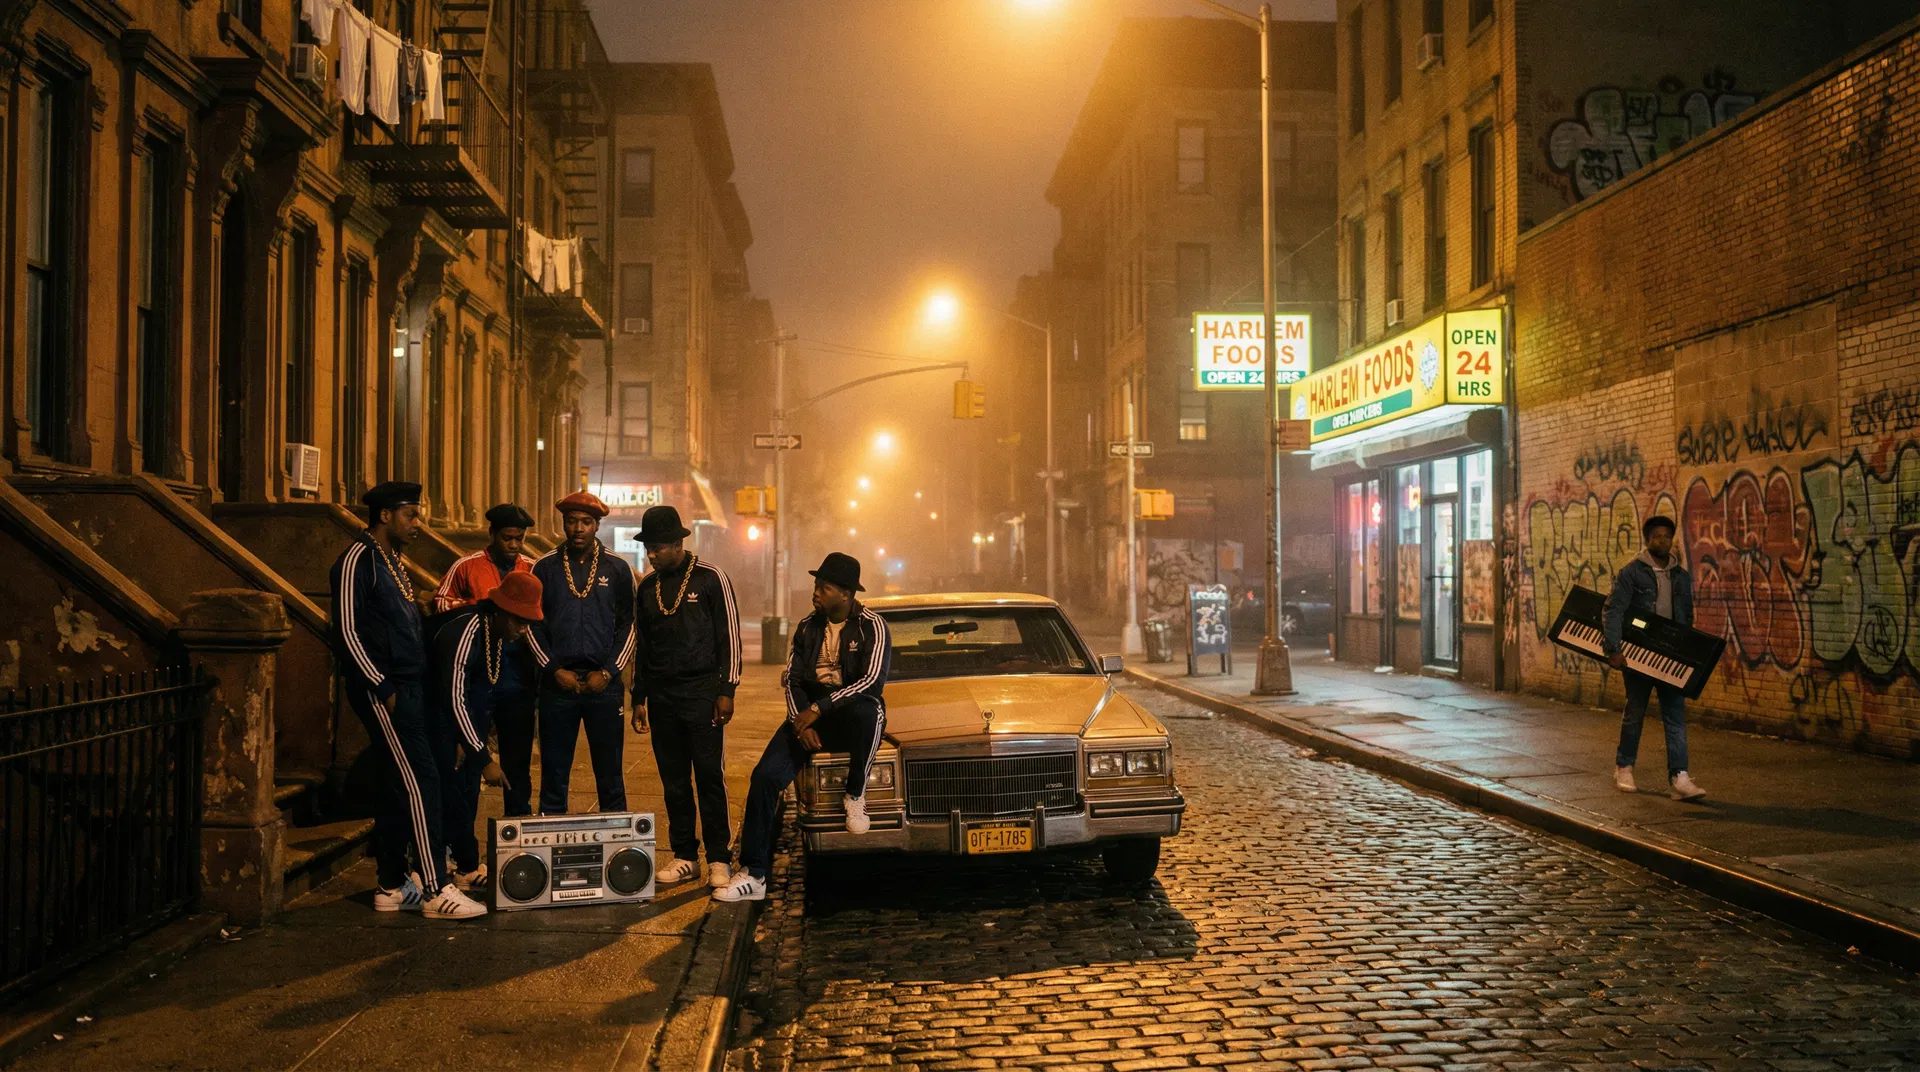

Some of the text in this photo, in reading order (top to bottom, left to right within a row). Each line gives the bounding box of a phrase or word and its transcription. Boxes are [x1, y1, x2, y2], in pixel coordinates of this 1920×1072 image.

[1203, 320, 1304, 339] HARLEM
[1451, 329, 1496, 345] OPEN
[1213, 345, 1295, 364] FOOS
[1456, 350, 1492, 375] 24
[1206, 371, 1246, 383] OPEN
[1310, 363, 1359, 416] HARLEM
[1364, 339, 1414, 398] FOODS
[1458, 381, 1491, 397] HRS
